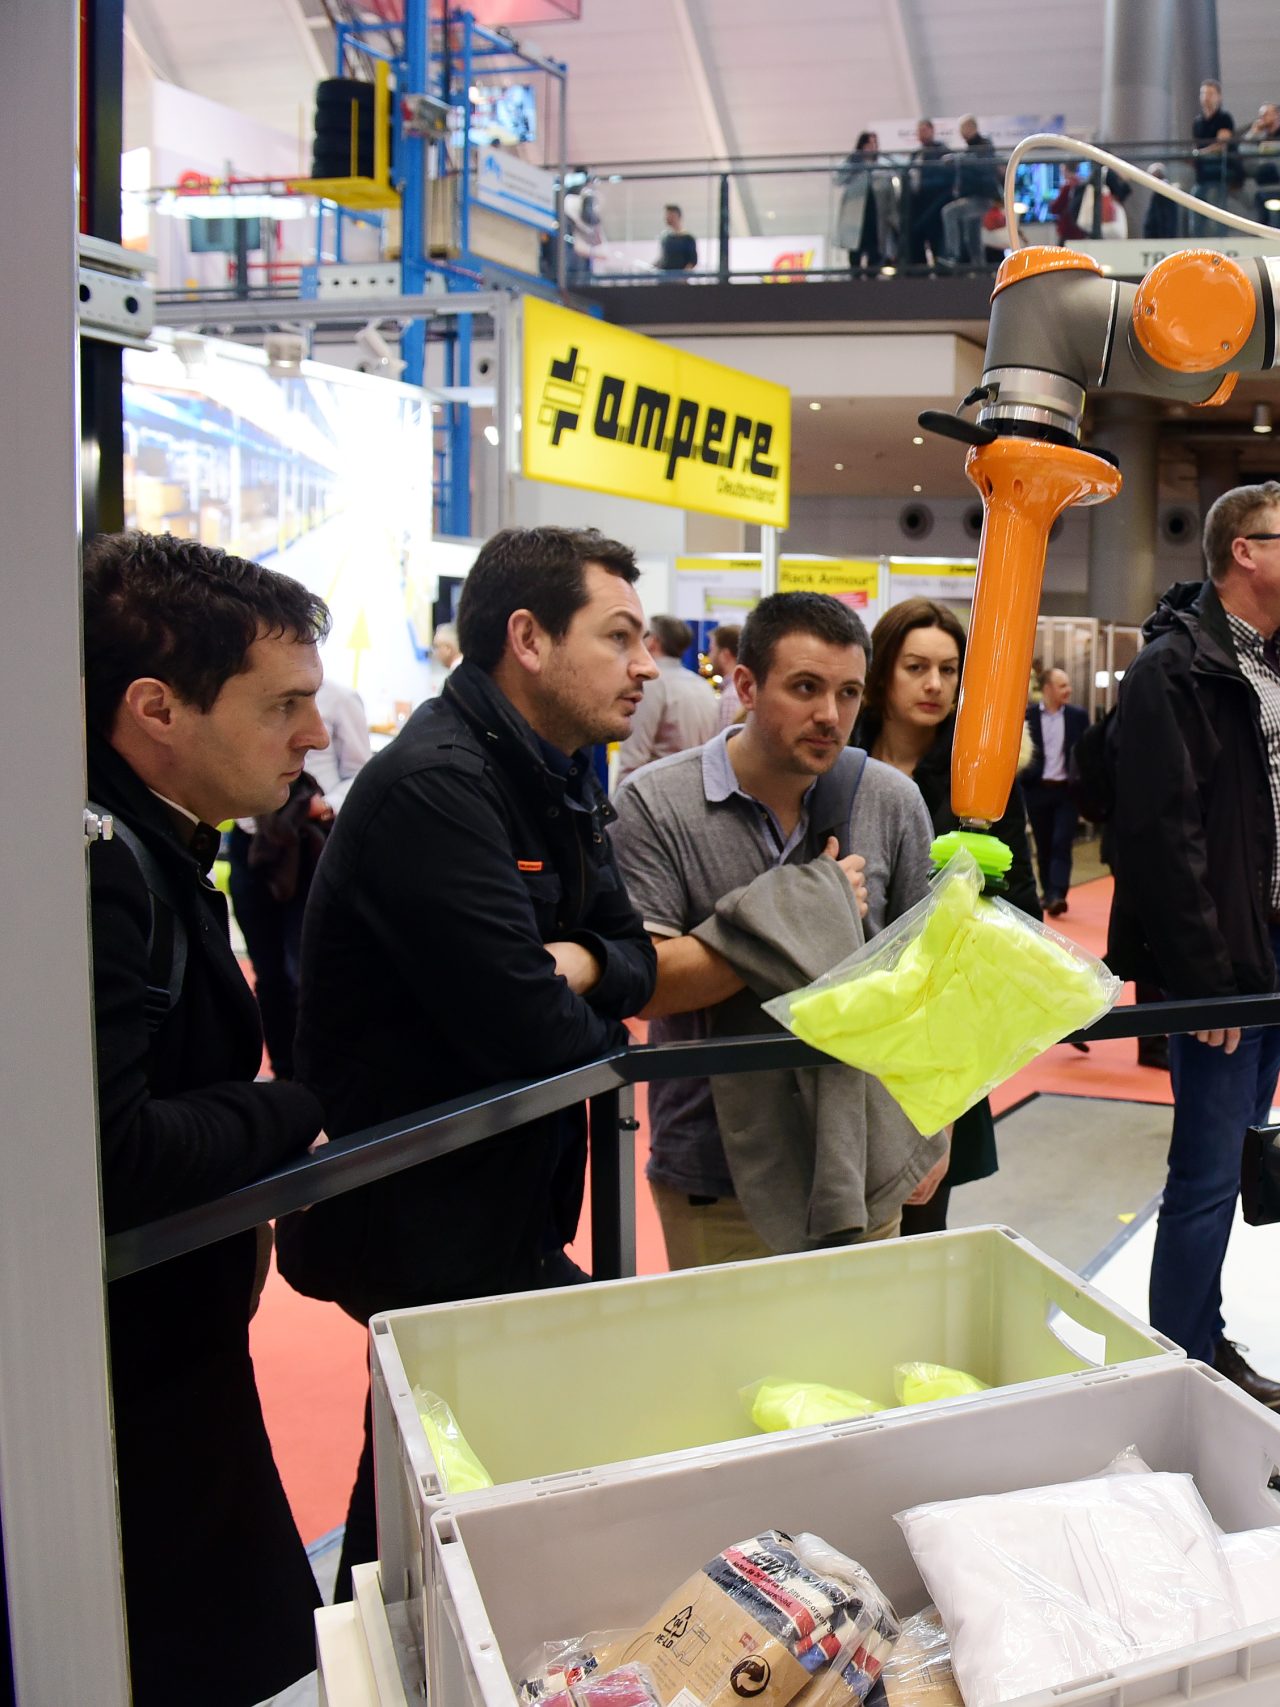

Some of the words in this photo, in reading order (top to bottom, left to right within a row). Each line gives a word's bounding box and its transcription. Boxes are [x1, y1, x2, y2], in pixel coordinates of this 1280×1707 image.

[594, 374, 779, 481] ampere
[717, 476, 778, 505] Deutschland
[654, 1633, 674, 1649] PE-LD
